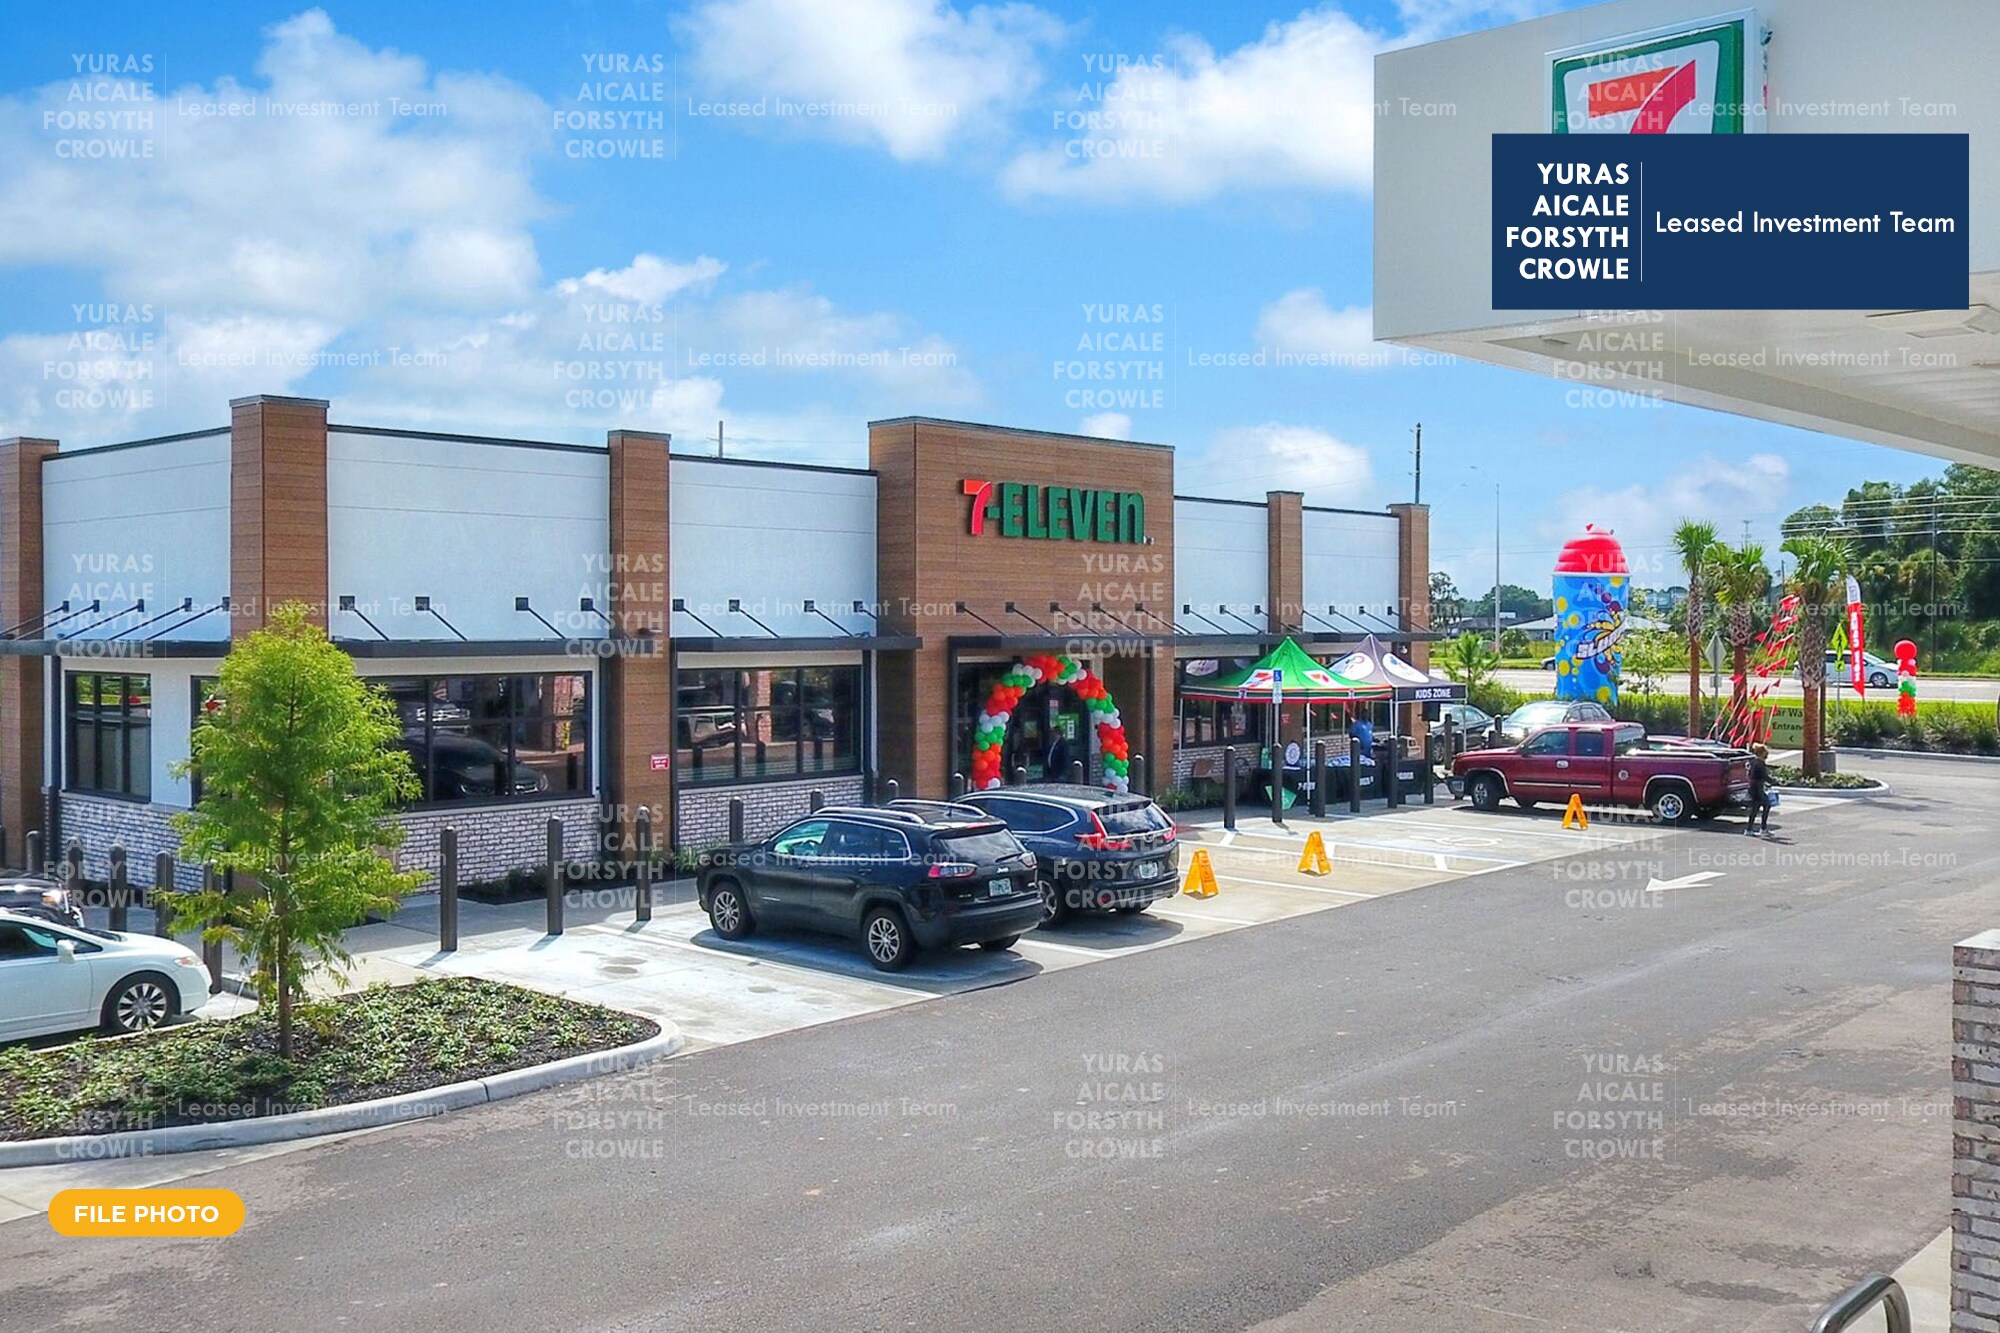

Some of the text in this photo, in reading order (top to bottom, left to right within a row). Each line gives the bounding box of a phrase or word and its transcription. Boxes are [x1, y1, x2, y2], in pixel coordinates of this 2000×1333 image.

[1588, 59, 1697, 134] 7
[1415, 688, 1451, 699] KIDS ZONE
[1772, 722, 1803, 731] Entran
